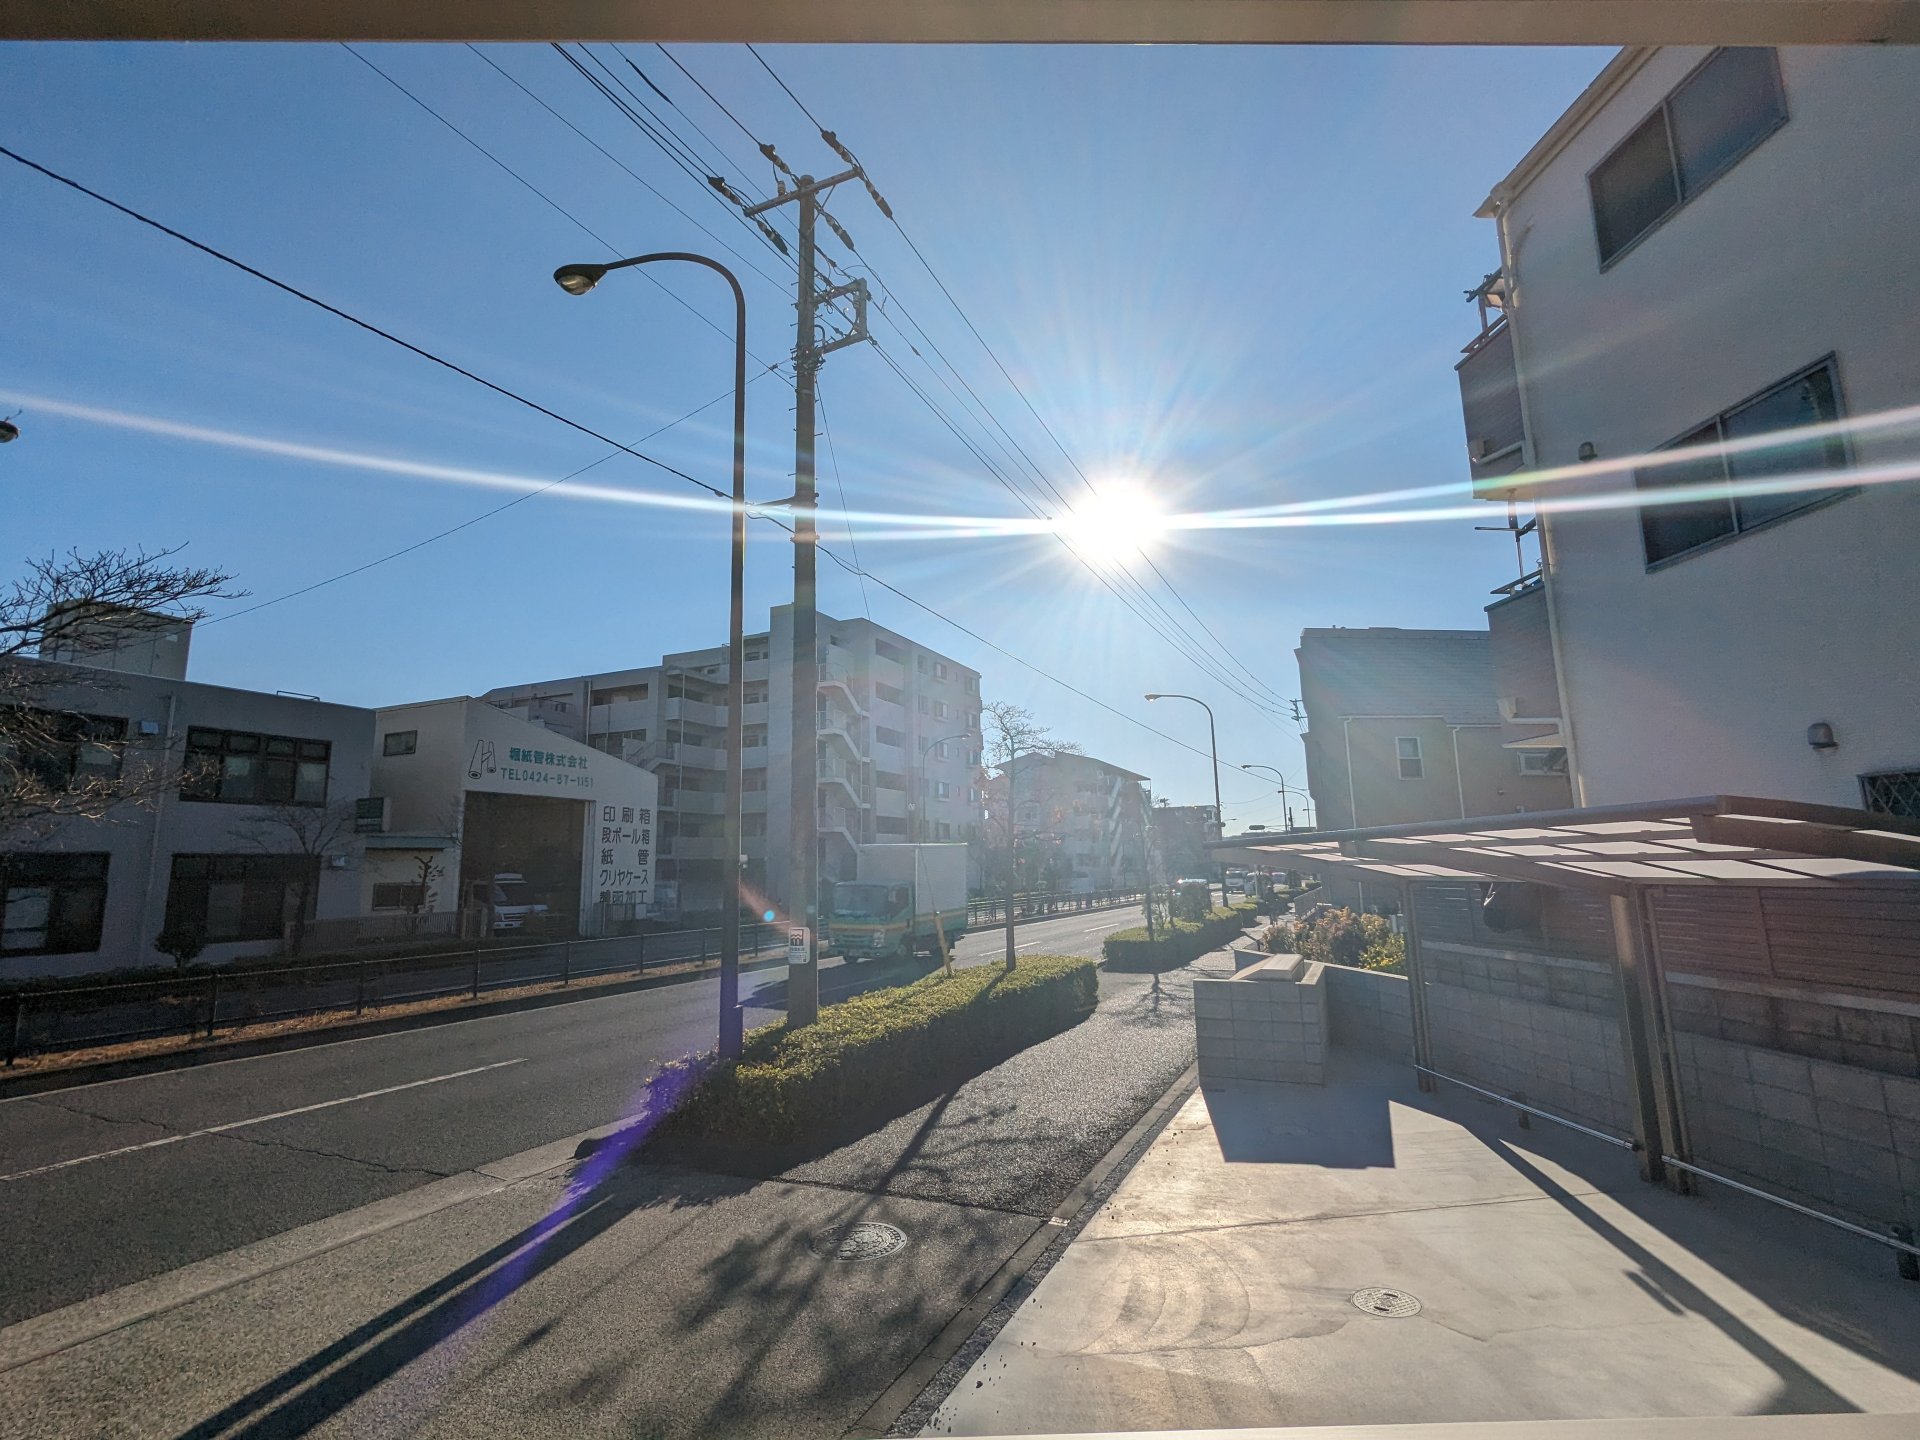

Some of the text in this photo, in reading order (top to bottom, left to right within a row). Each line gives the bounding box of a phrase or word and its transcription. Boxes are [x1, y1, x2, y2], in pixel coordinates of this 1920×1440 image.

[601, 827, 650, 845] 段ボール箱
[599, 869, 648, 887] クリヤケース
